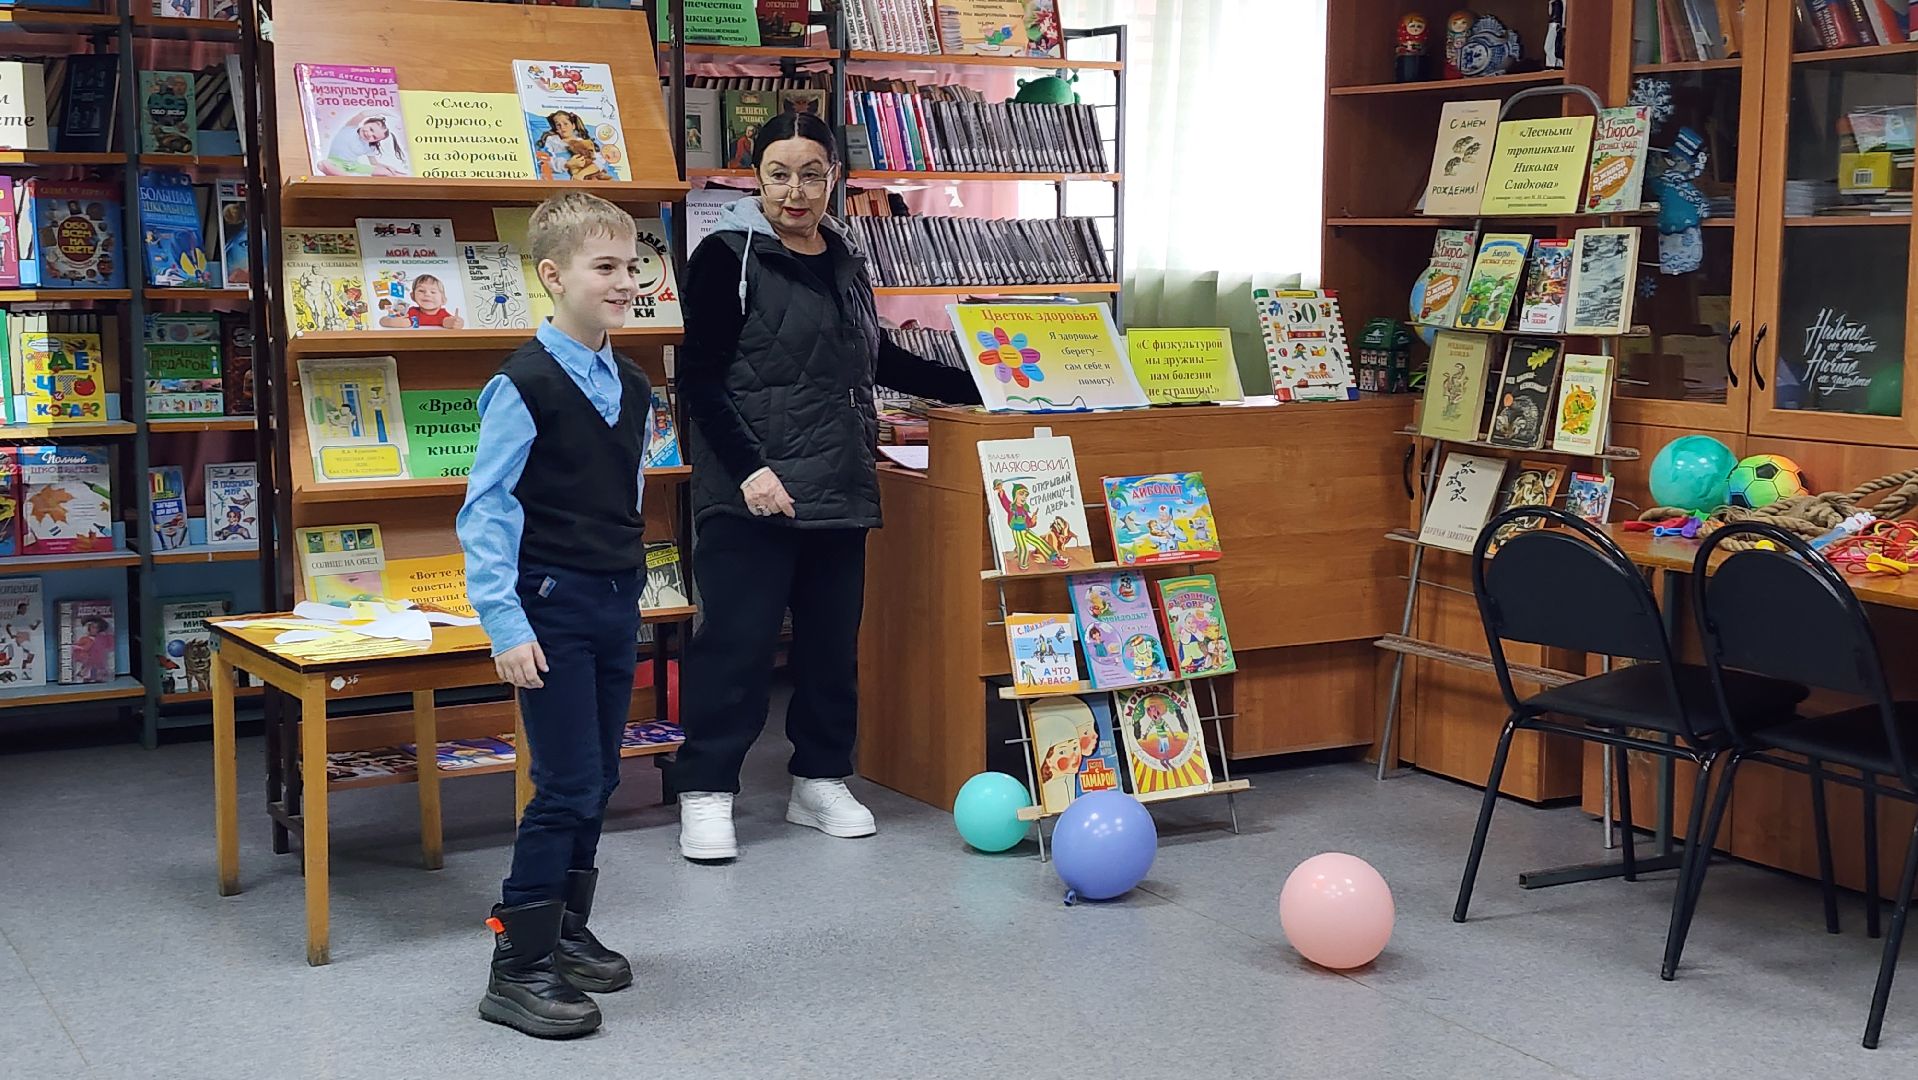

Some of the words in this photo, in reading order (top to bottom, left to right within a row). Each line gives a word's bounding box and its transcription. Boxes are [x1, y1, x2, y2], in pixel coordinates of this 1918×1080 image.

[316, 97, 340, 107] это
[342, 97, 395, 107] весело!
[432, 97, 494, 111] «Смело,
[426, 114, 493, 129] дружно,
[495, 118, 503, 128] с
[1450, 118, 1458, 129] С
[1519, 126, 1574, 138] «Лесными
[1605, 117, 1637, 141] Бюро
[414, 135, 520, 145] оптимизмом
[423, 152, 440, 162] за
[444, 148, 518, 162] здоровый
[1506, 143, 1576, 157] тропинками
[422, 165, 467, 179] образ
[469, 168, 529, 179] жизни»
[1513, 162, 1559, 173] Николая
[1432, 183, 1479, 196] РОЖДЕНИЯ!
[1504, 179, 1559, 191] Сладкова»
[385, 247, 411, 258] МОЙ
[412, 249, 438, 258] ДОМ
[981, 308, 1034, 323] Цветок
[1037, 309, 1099, 324] здоровья
[1048, 331, 1056, 340] Я
[1058, 332, 1099, 342] здоровье
[1804, 307, 1871, 355] Никто
[1136, 339, 1150, 350] «С
[1152, 337, 1223, 352] физкультурой
[1827, 342, 1840, 352] не
[1061, 347, 1095, 358] сберегу
[1064, 363, 1082, 371] сам
[1083, 362, 1103, 371] себе
[1145, 356, 1162, 365] мы
[1163, 355, 1205, 368] дружны
[1150, 371, 1170, 381] нам
[1171, 369, 1212, 381] болезни
[1078, 376, 1115, 387] помогу!
[1148, 387, 1162, 397] не
[1163, 385, 1220, 400] страшны!»
[989, 457, 1071, 474] МАЯКОВСКИЙ
[1031, 472, 1072, 495] ОТКРЫВАЙ
[1132, 483, 1183, 500] АЙБОЛИТ
[311, 559, 343, 570] СОЛНЦЕ
[343, 559, 356, 569] НА
[356, 556, 380, 567] ОБЕД
[409, 570, 438, 580] «Вот
[438, 569, 452, 577] те
[411, 582, 457, 593] советы,
[1044, 668, 1051, 676] А
[1051, 666, 1071, 676] ЧТО
[1038, 677, 1045, 686] У
[1046, 676, 1072, 686] ВАС?
[1081, 770, 1117, 788] ТАМАРОЙ
